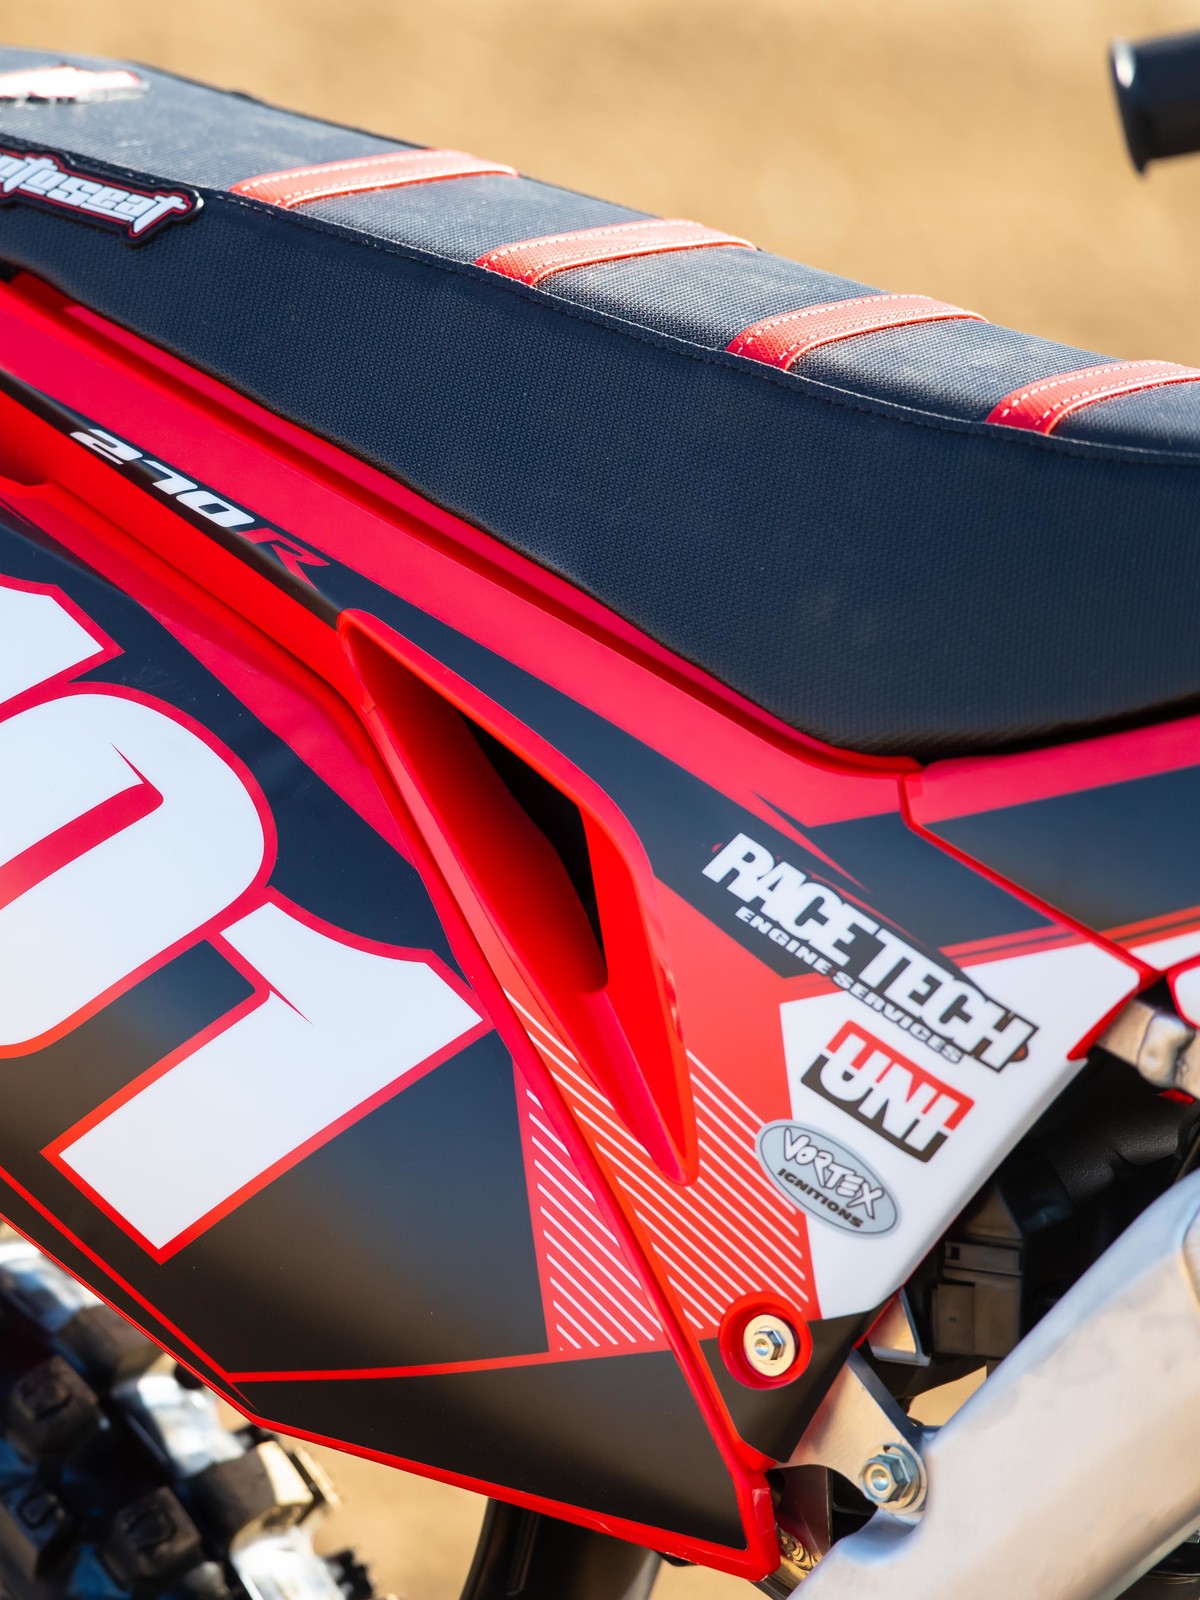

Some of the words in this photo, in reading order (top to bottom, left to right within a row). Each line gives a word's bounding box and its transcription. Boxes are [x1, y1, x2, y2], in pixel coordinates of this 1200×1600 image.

[735, 906, 832, 976] ENGINE
[832, 974, 963, 1064] SERVICES
[819, 1031, 961, 1153] UNI
[777, 1167, 865, 1229] IGNITIONS
